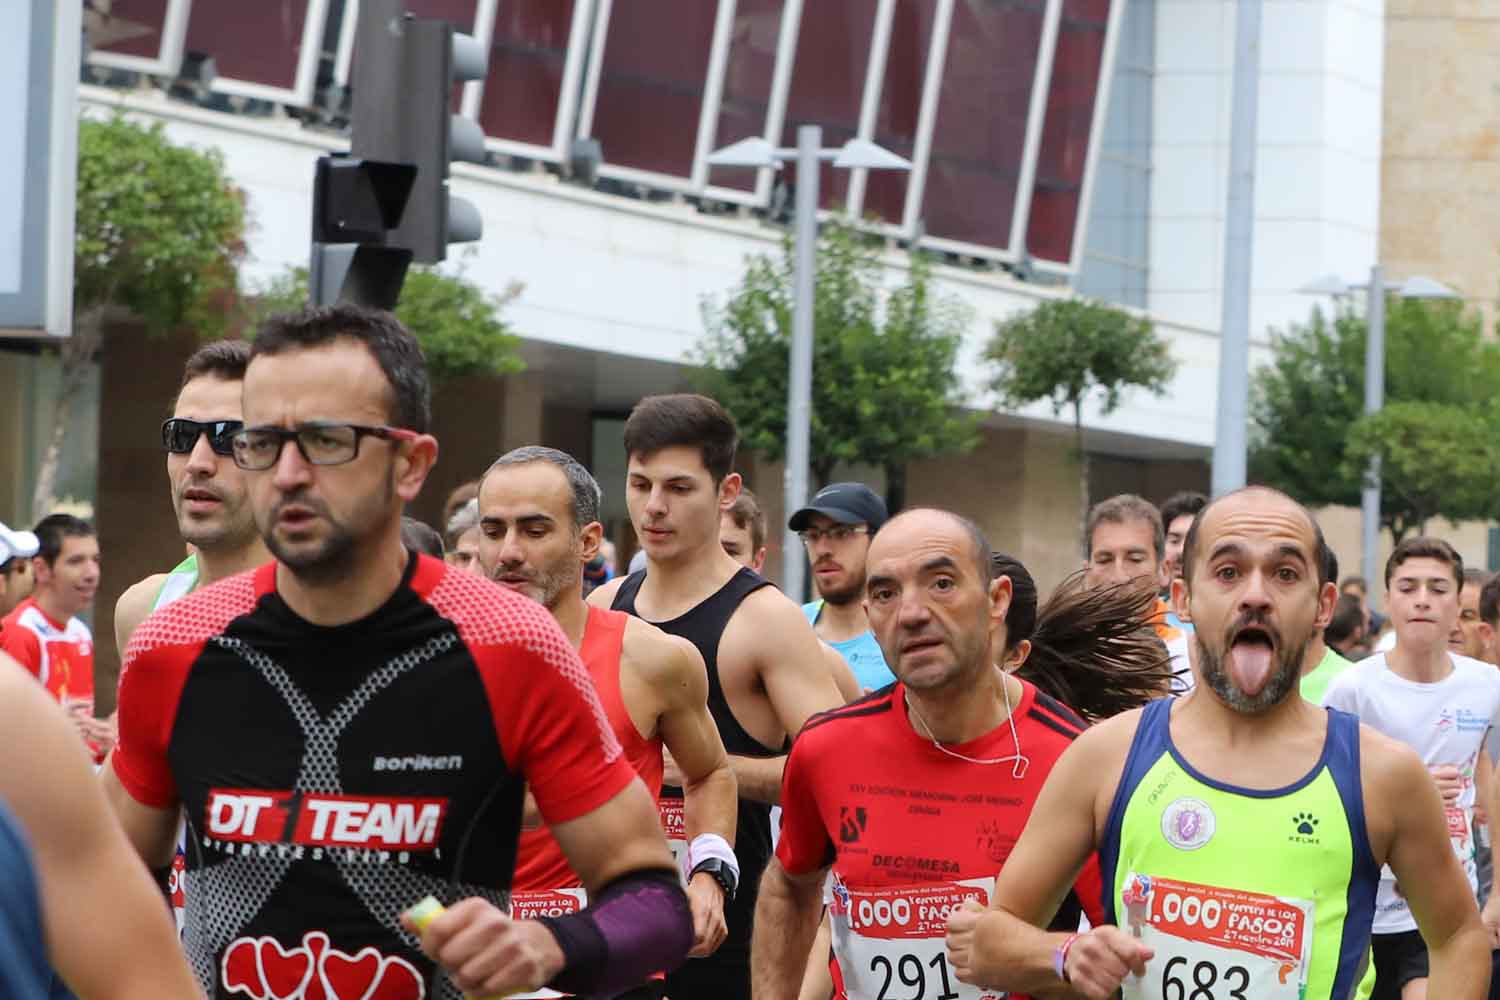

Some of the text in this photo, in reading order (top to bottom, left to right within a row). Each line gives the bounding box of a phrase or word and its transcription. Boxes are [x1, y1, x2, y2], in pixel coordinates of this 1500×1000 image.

[209, 793, 273, 837] DT
[307, 799, 442, 844] TEAM
[1288, 836, 1321, 844] KELME
[872, 855, 960, 874] DECOMESA
[1145, 889, 1221, 929] 1.000
[1279, 910, 1297, 921] LOS
[1228, 913, 1296, 939] PASOS
